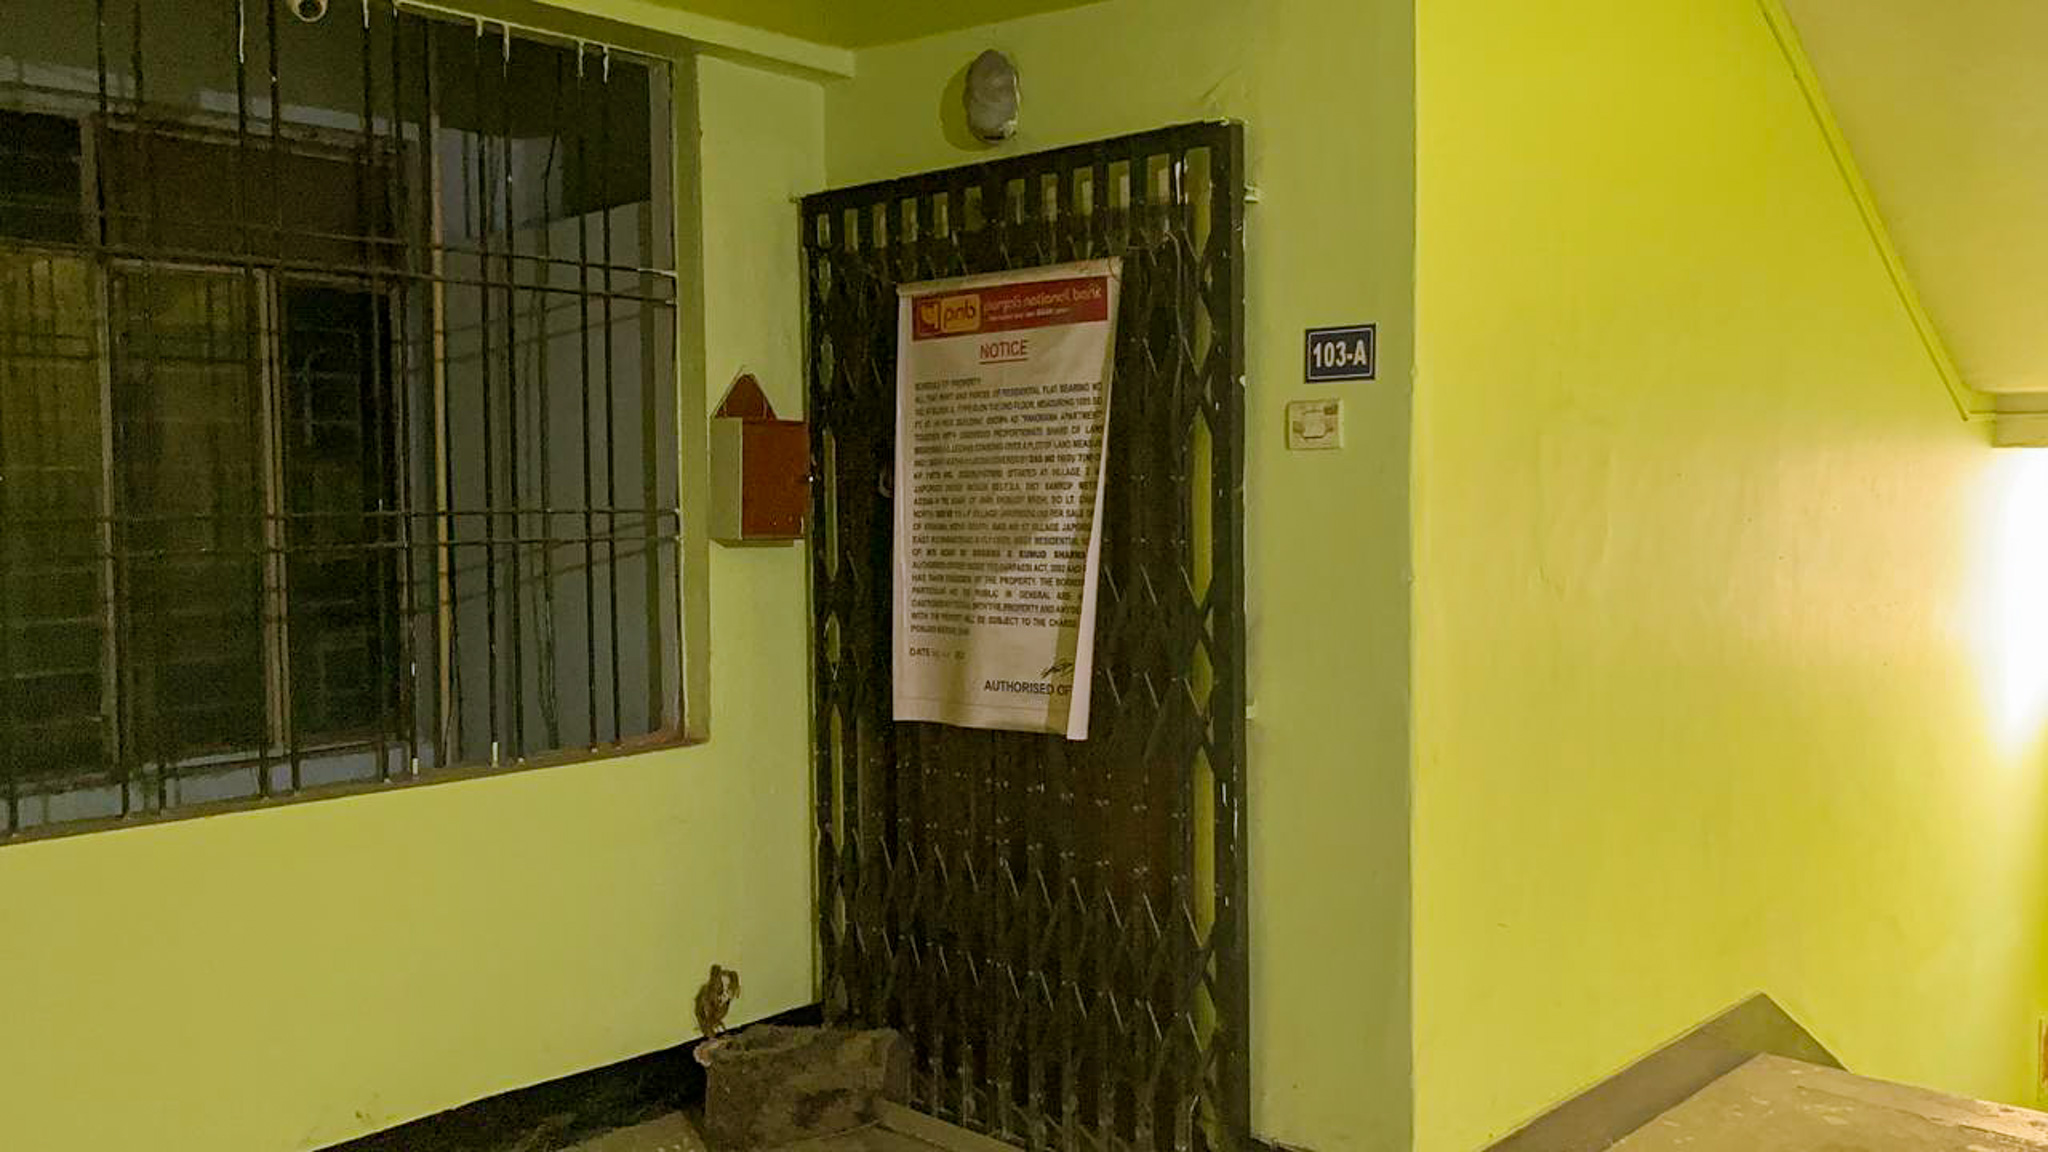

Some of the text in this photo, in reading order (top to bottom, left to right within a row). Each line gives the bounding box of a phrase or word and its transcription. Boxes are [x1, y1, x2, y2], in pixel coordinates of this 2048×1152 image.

[1074, 283, 1102, 300] bank
[944, 300, 975, 321] pnb
[980, 340, 1030, 358] NOTICE
[1313, 339, 1367, 368] 103-A
[909, 647, 930, 657] DATE
[983, 678, 1054, 695] AUTHORISED
